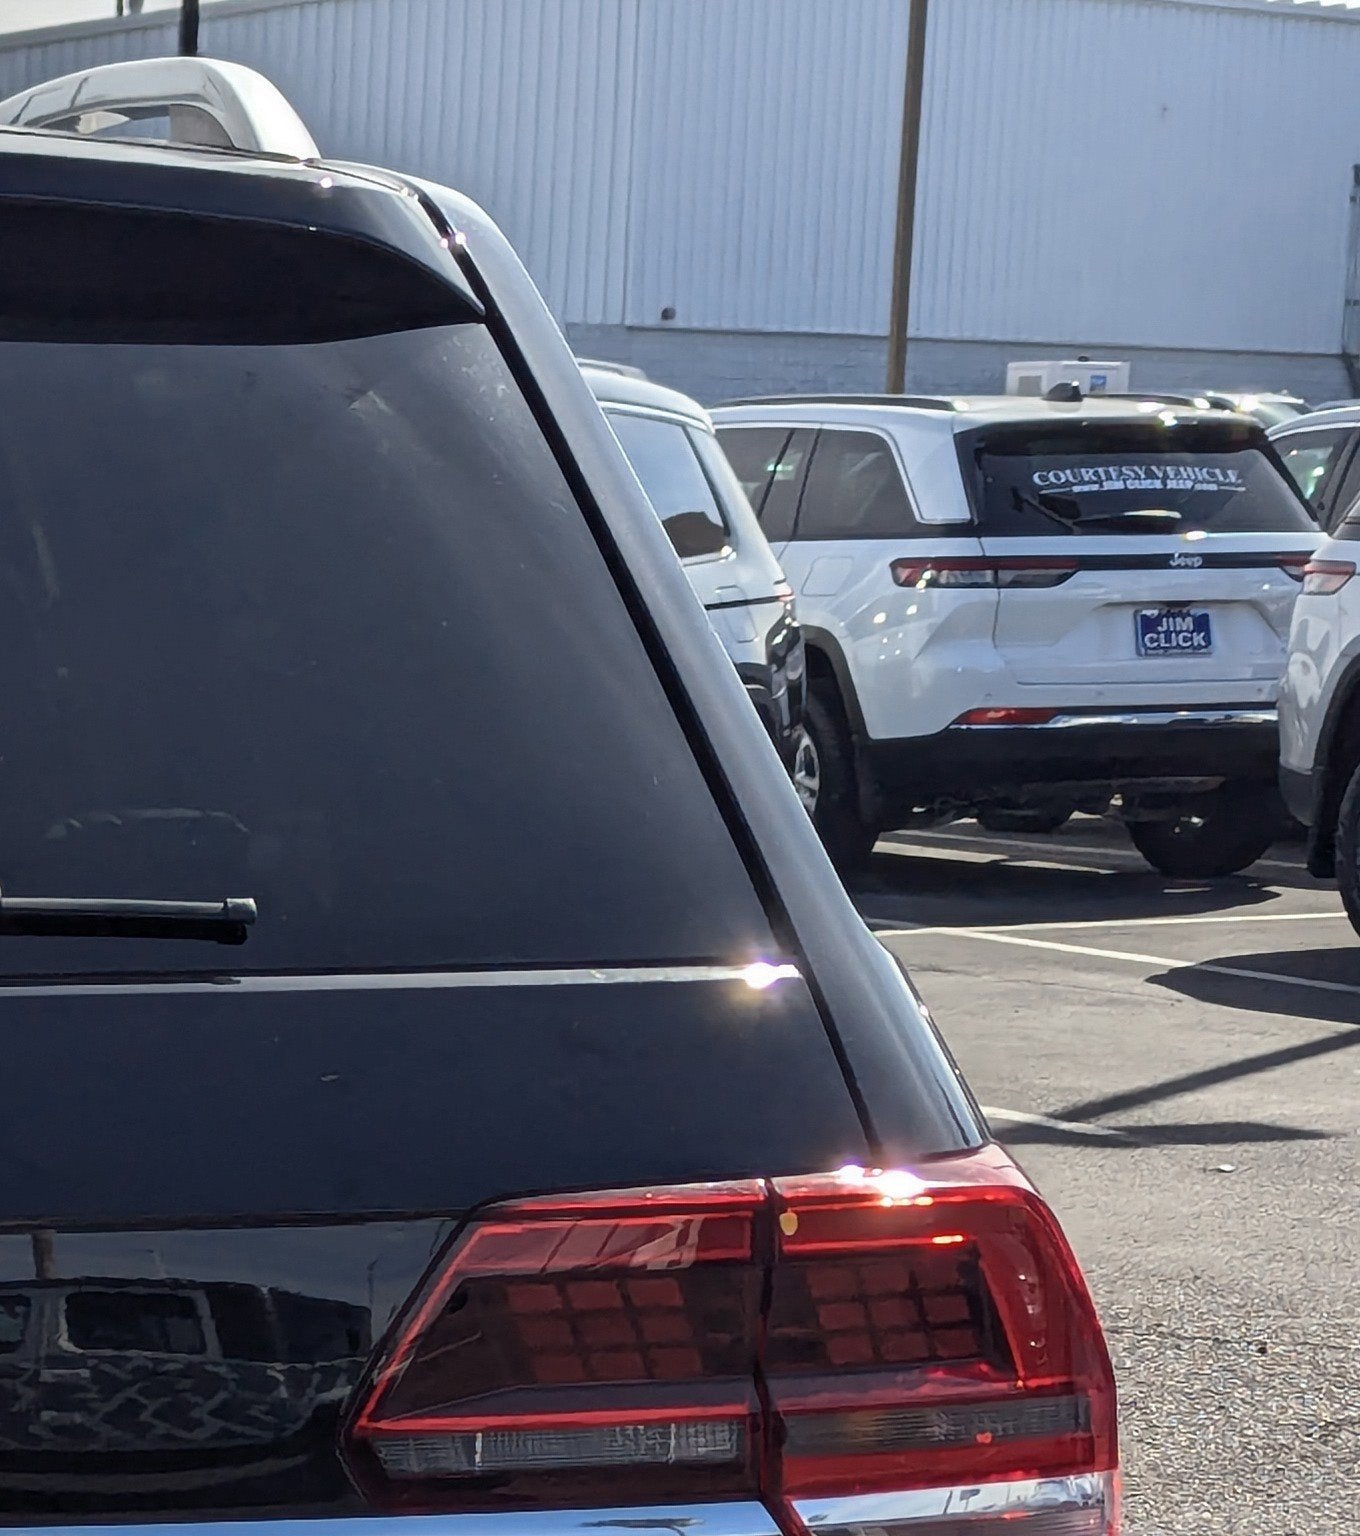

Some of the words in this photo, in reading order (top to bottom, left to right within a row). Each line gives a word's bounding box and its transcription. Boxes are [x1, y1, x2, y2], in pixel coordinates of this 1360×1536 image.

[1032, 466, 1146, 486] COURTESY
[1150, 465, 1243, 484] VEHICLE
[1169, 551, 1203, 568] Jeep
[1157, 616, 1194, 632] JIM
[1144, 631, 1207, 648] CLICK
